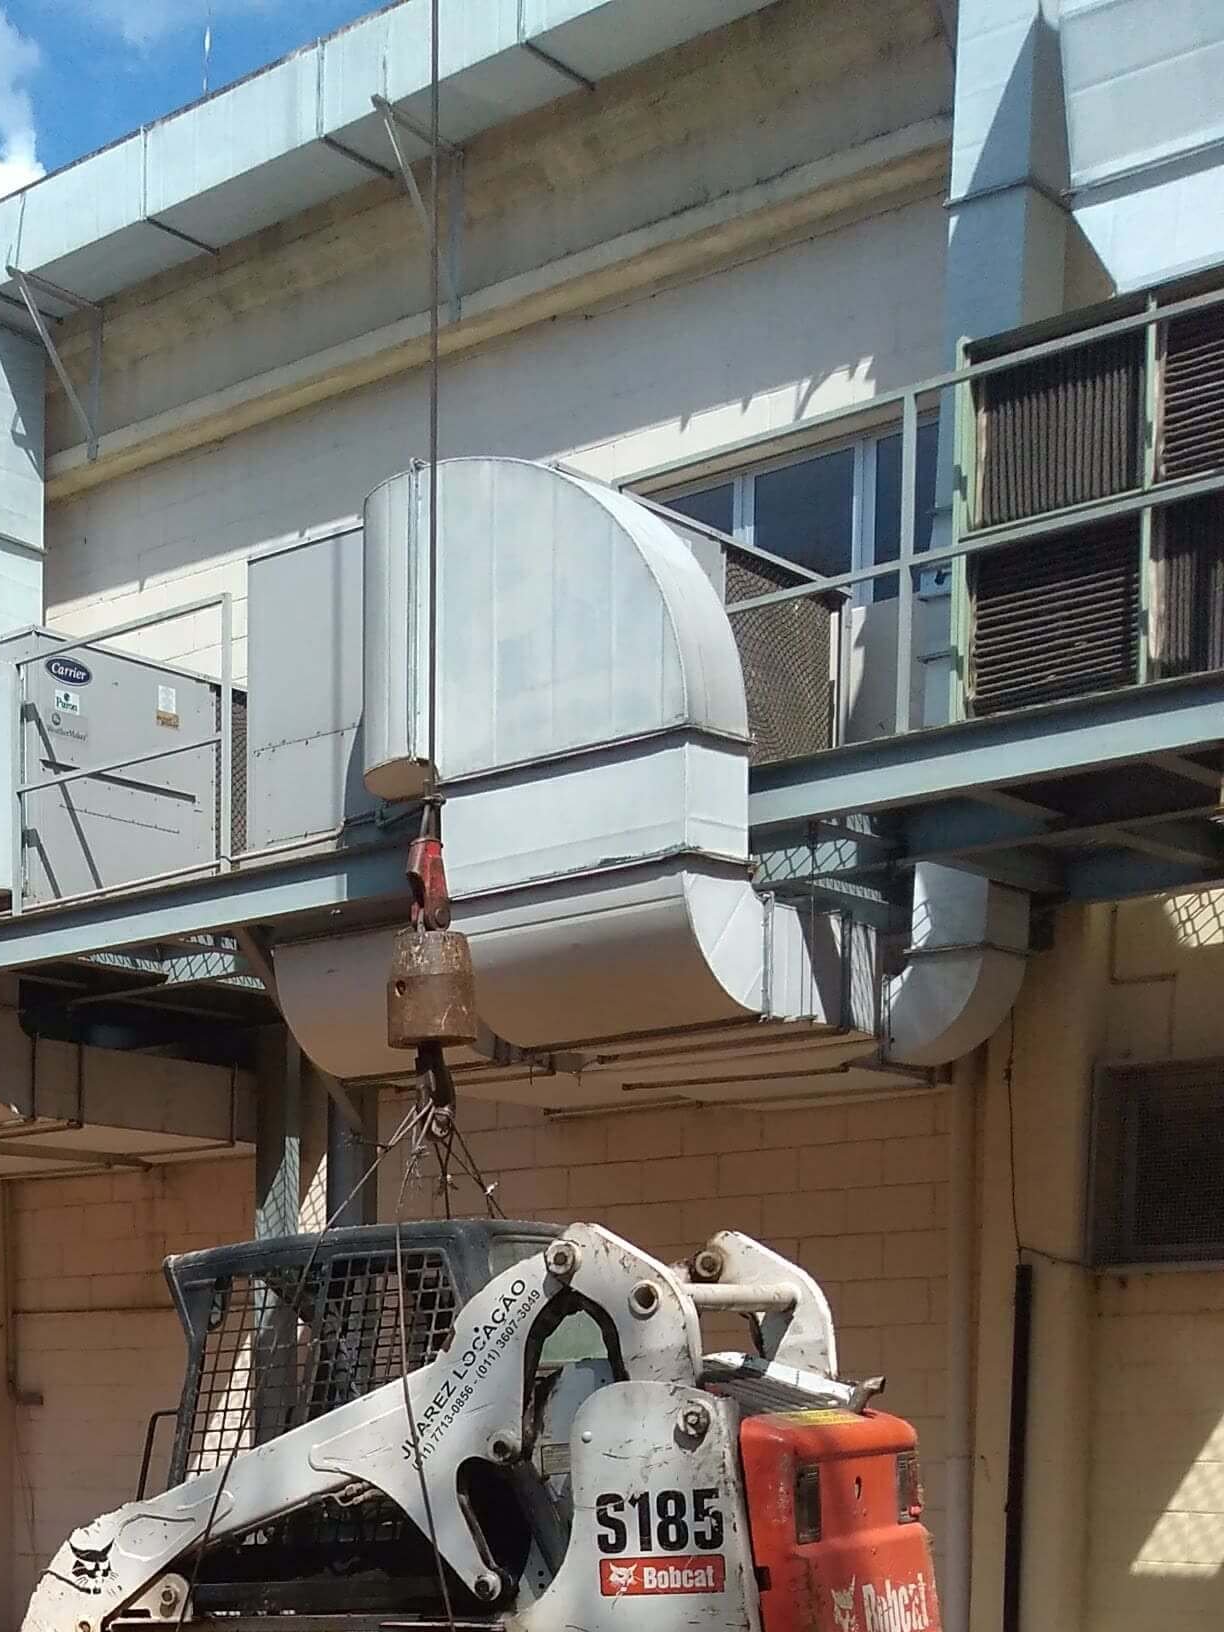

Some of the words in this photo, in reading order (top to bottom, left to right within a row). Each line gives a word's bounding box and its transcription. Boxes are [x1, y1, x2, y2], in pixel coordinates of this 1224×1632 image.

[51, 662, 87, 681] Carrier
[401, 1380, 457, 1460] JUAREZ
[453, 1279, 526, 1380] LOCAÇÃO
[431, 1385, 474, 1442] 7713-0856
[476, 1349, 501, 1379] (011)
[496, 1289, 540, 1349] 3607-3049
[595, 1487, 724, 1554] S185
[643, 1564, 715, 1590] Bobcat
